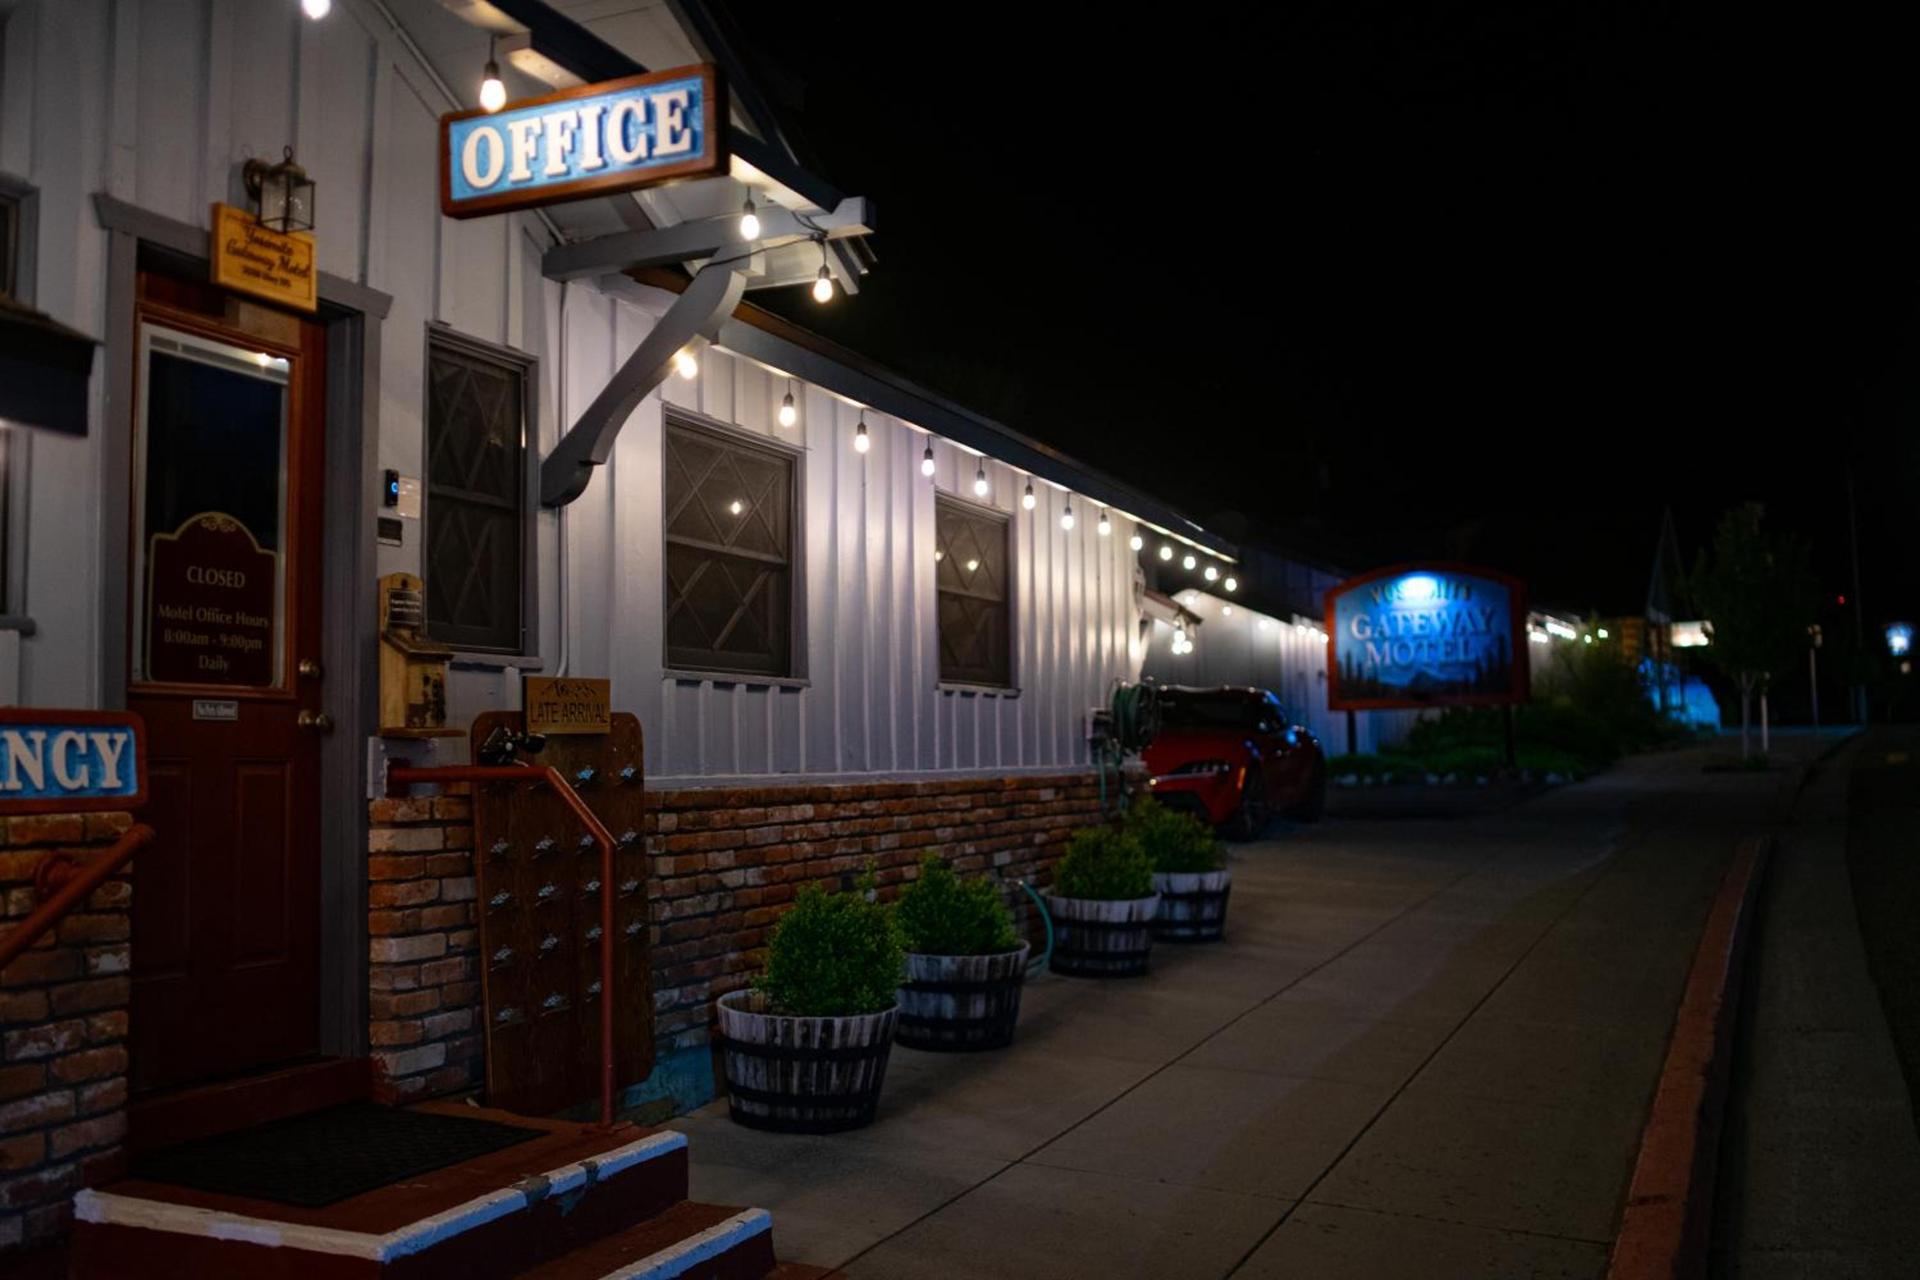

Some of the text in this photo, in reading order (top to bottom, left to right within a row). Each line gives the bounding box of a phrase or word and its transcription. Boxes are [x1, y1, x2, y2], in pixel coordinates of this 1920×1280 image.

[462, 90, 692, 188] OFFICE
[186, 565, 246, 588] CLOSED
[158, 603, 269, 628] Motel Office Hours
[1350, 606, 1495, 641] GATEWAY
[163, 628, 209, 646] 8:00am
[198, 655, 229, 674] Daily
[1365, 638, 1477, 666] MOTEL
[530, 702, 609, 725] LATE ARRIVAL
[0, 729, 128, 791] NCY
